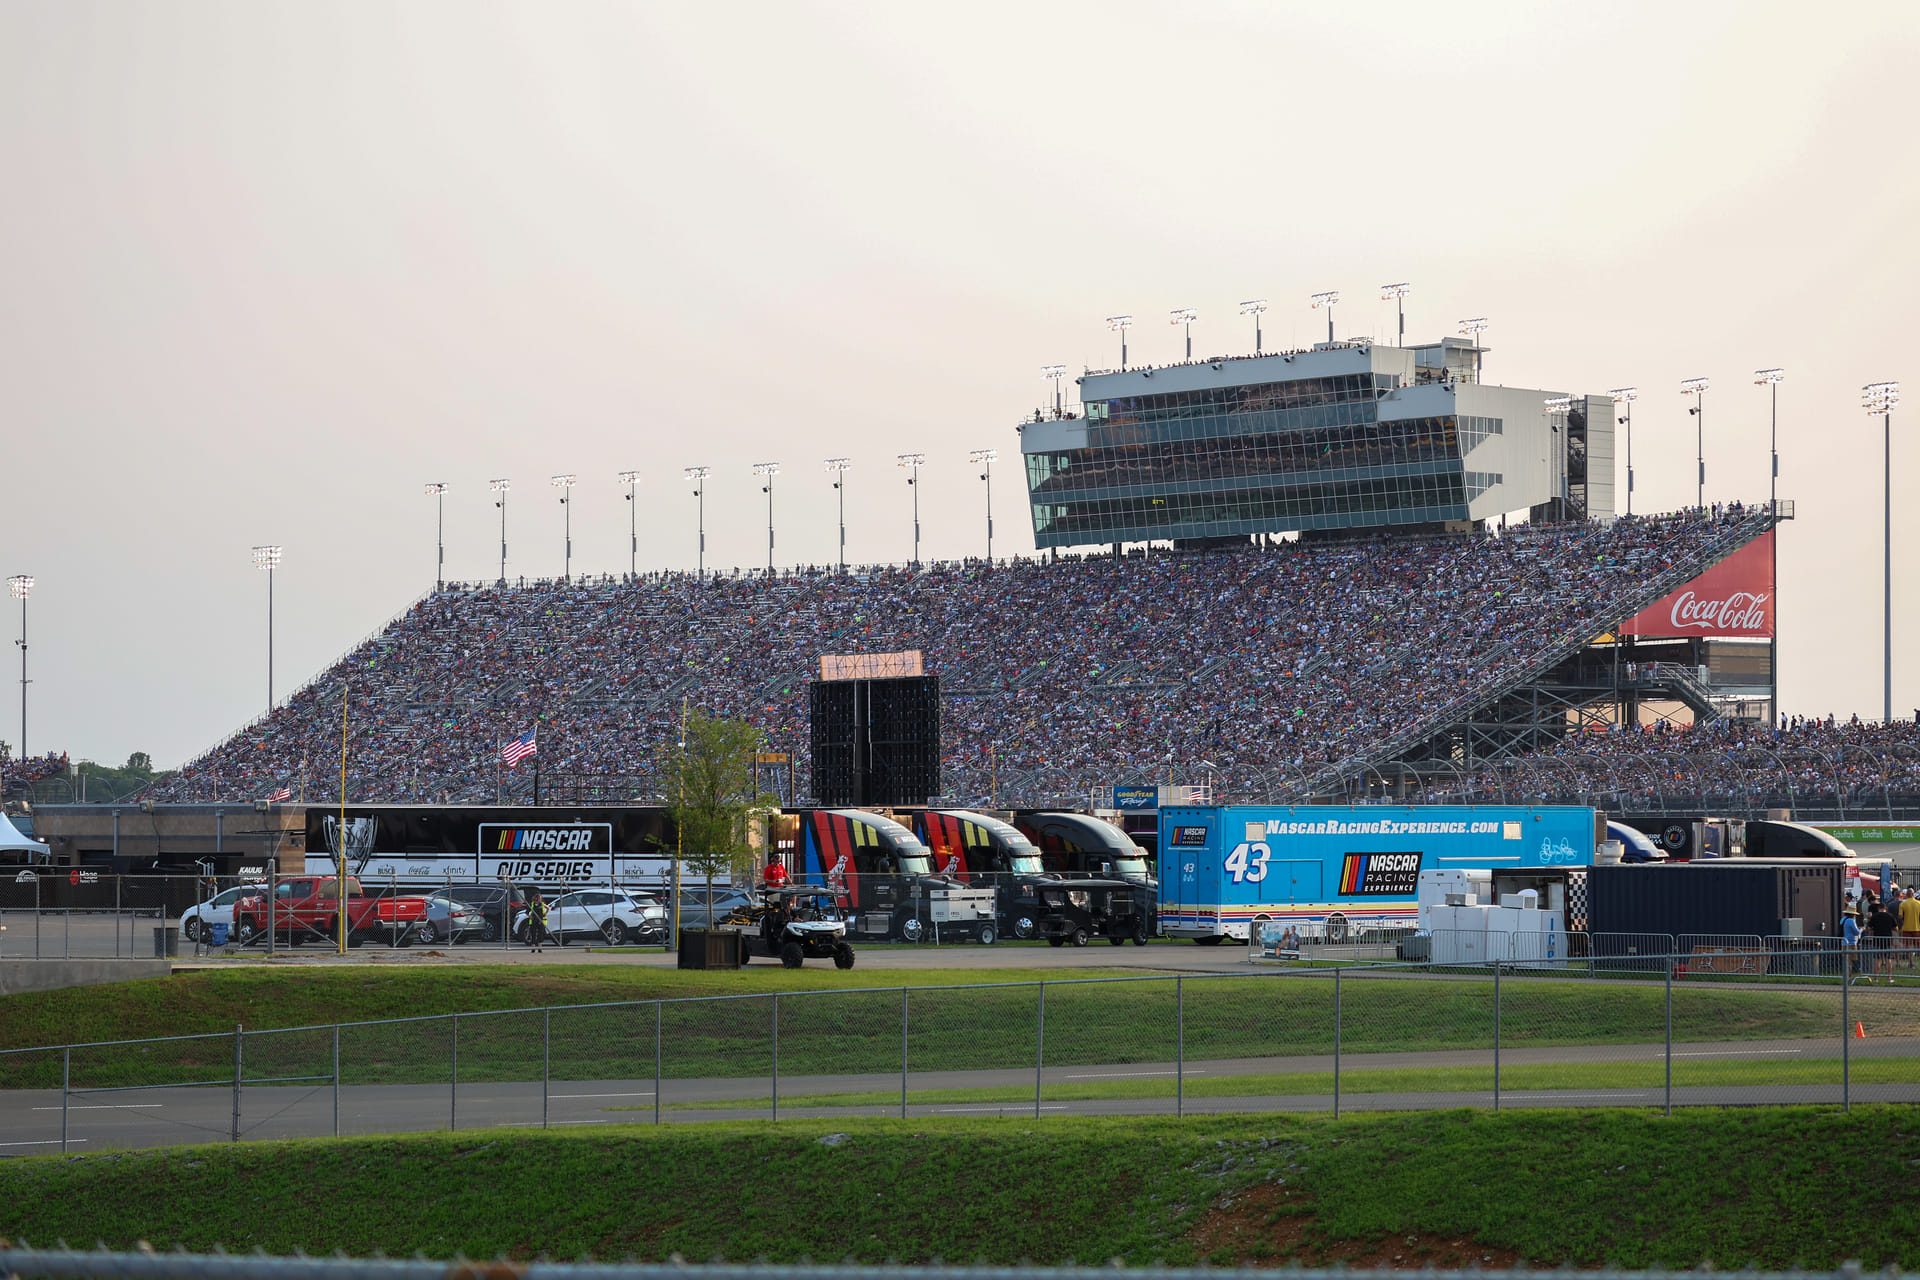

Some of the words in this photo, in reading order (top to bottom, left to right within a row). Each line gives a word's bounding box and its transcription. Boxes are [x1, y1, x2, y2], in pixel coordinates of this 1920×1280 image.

[1671, 591, 1770, 629] Coca-Cola
[1184, 828, 1207, 836] NASCAR
[520, 830, 593, 850] NASCAR
[442, 865, 466, 875] xfinity
[1183, 862, 1195, 873] 43
[1224, 842, 1271, 884] 43
[1368, 855, 1418, 872] NASCAR
[497, 862, 531, 880] CUP
[534, 862, 594, 880] SERIES
[1366, 873, 1416, 882] RACING
[1364, 884, 1414, 892] EXPERIENCE
